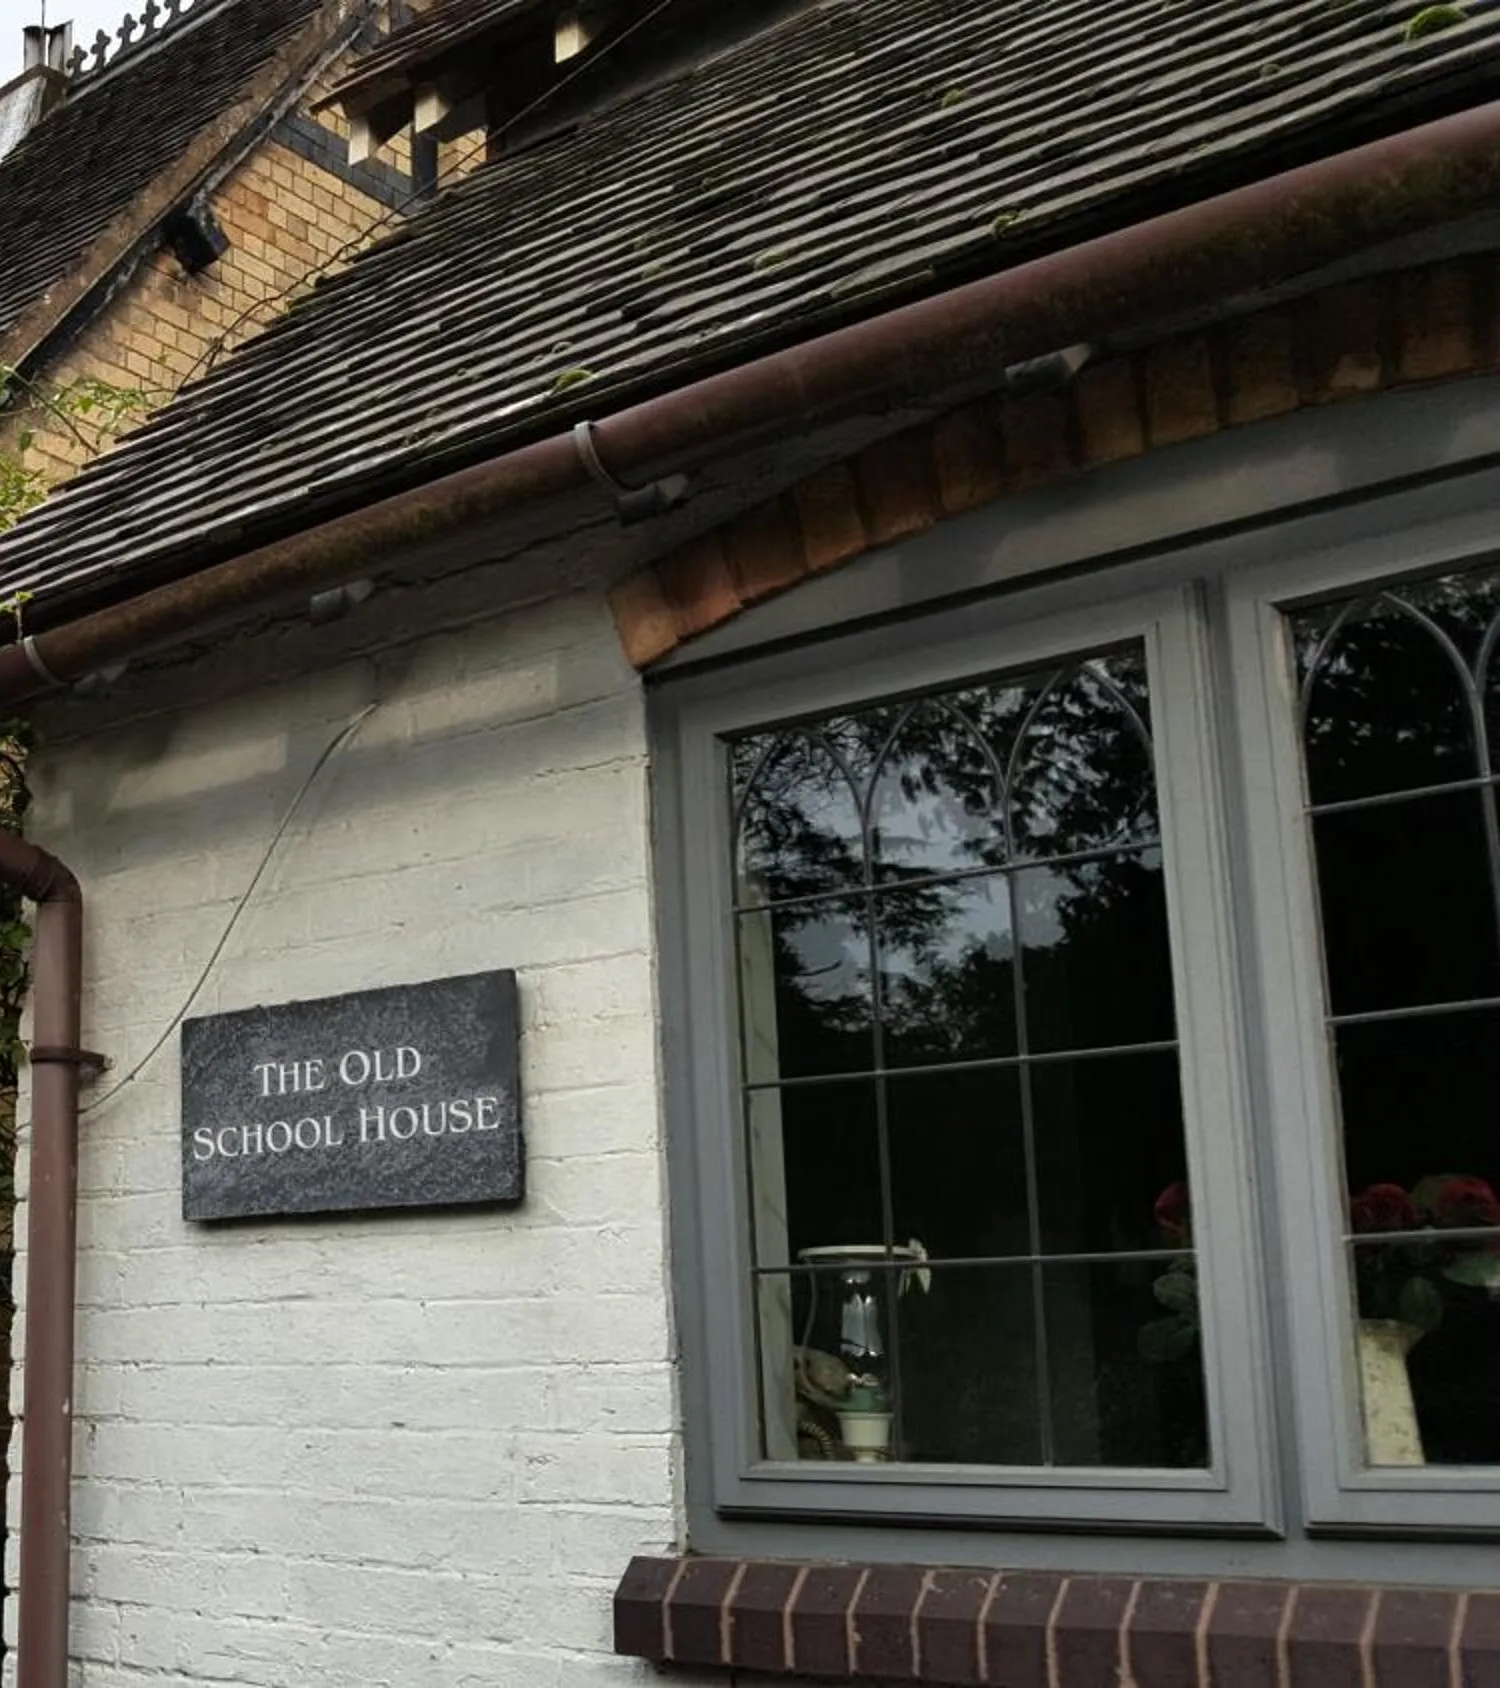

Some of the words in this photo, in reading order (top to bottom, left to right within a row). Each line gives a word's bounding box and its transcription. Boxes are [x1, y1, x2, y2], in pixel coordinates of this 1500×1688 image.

[253, 1059, 326, 1097] THE
[339, 1047, 421, 1085] OLD
[193, 1115, 343, 1161] SCHOOL
[358, 1097, 500, 1142] HOUSE
